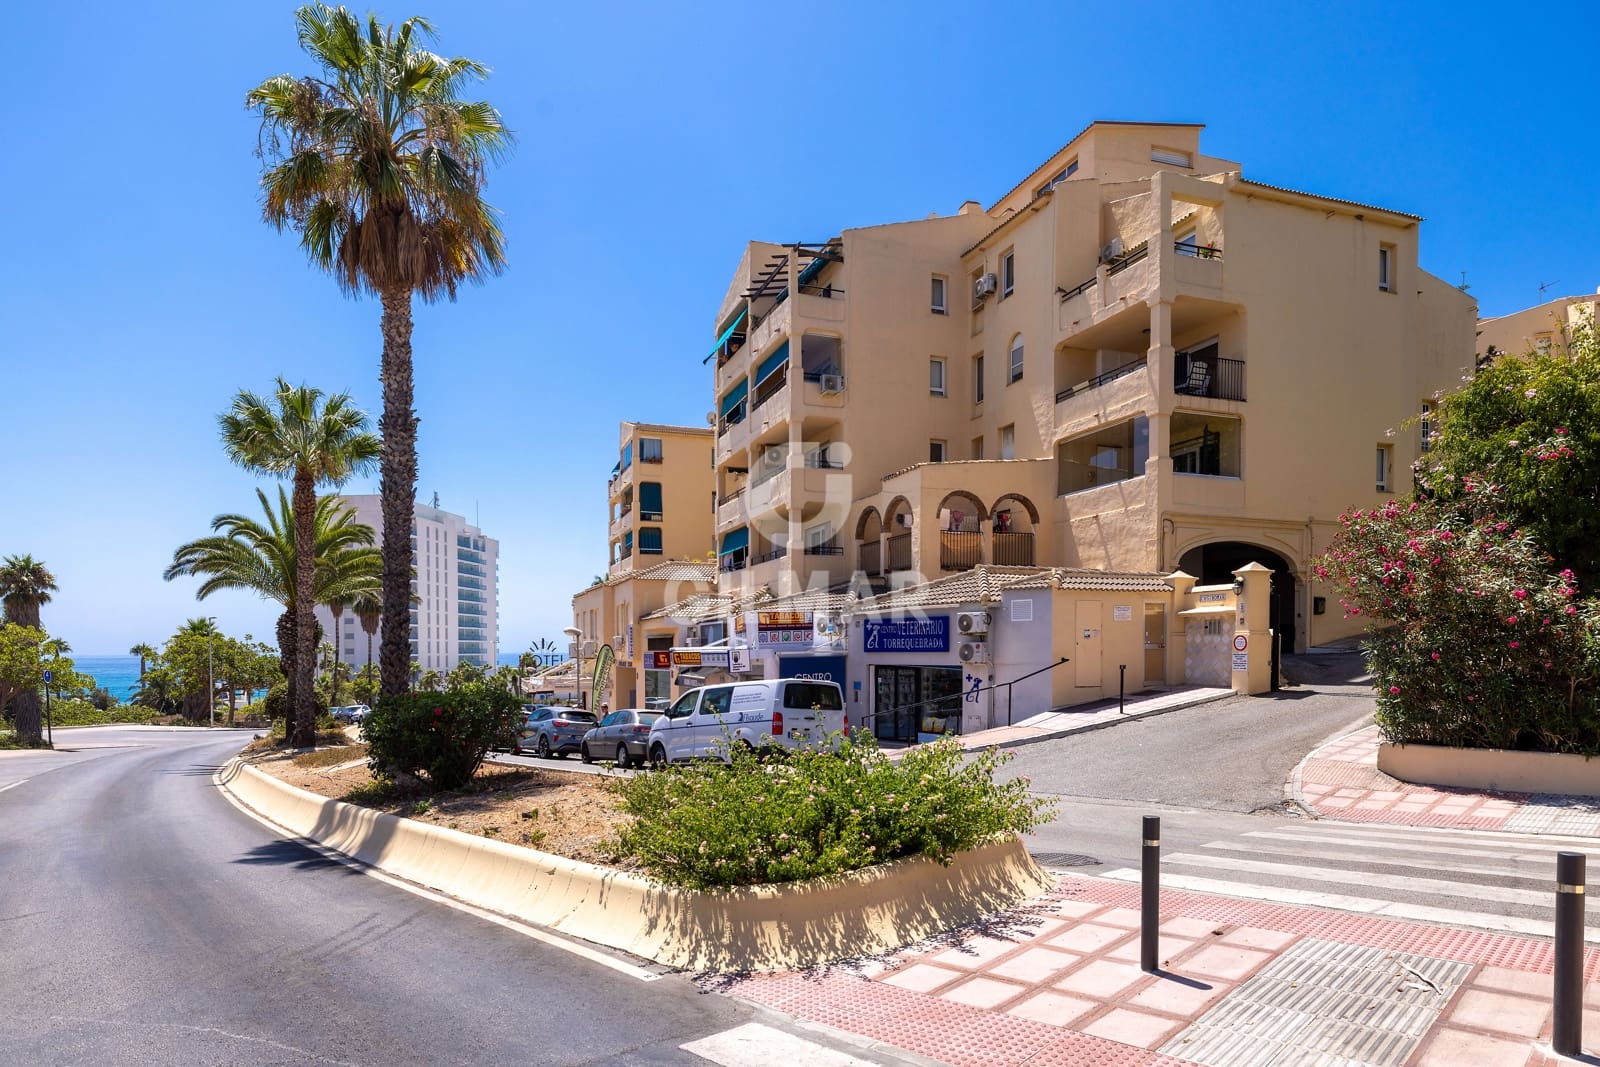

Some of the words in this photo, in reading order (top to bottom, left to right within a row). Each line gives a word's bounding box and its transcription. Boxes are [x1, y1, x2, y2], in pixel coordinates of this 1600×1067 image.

[771, 612, 804, 621] TABACOS
[897, 620, 944, 635] VETERINARIO
[883, 638, 944, 650] TORREQUEBRADA
[795, 672, 832, 680] CENTRO
